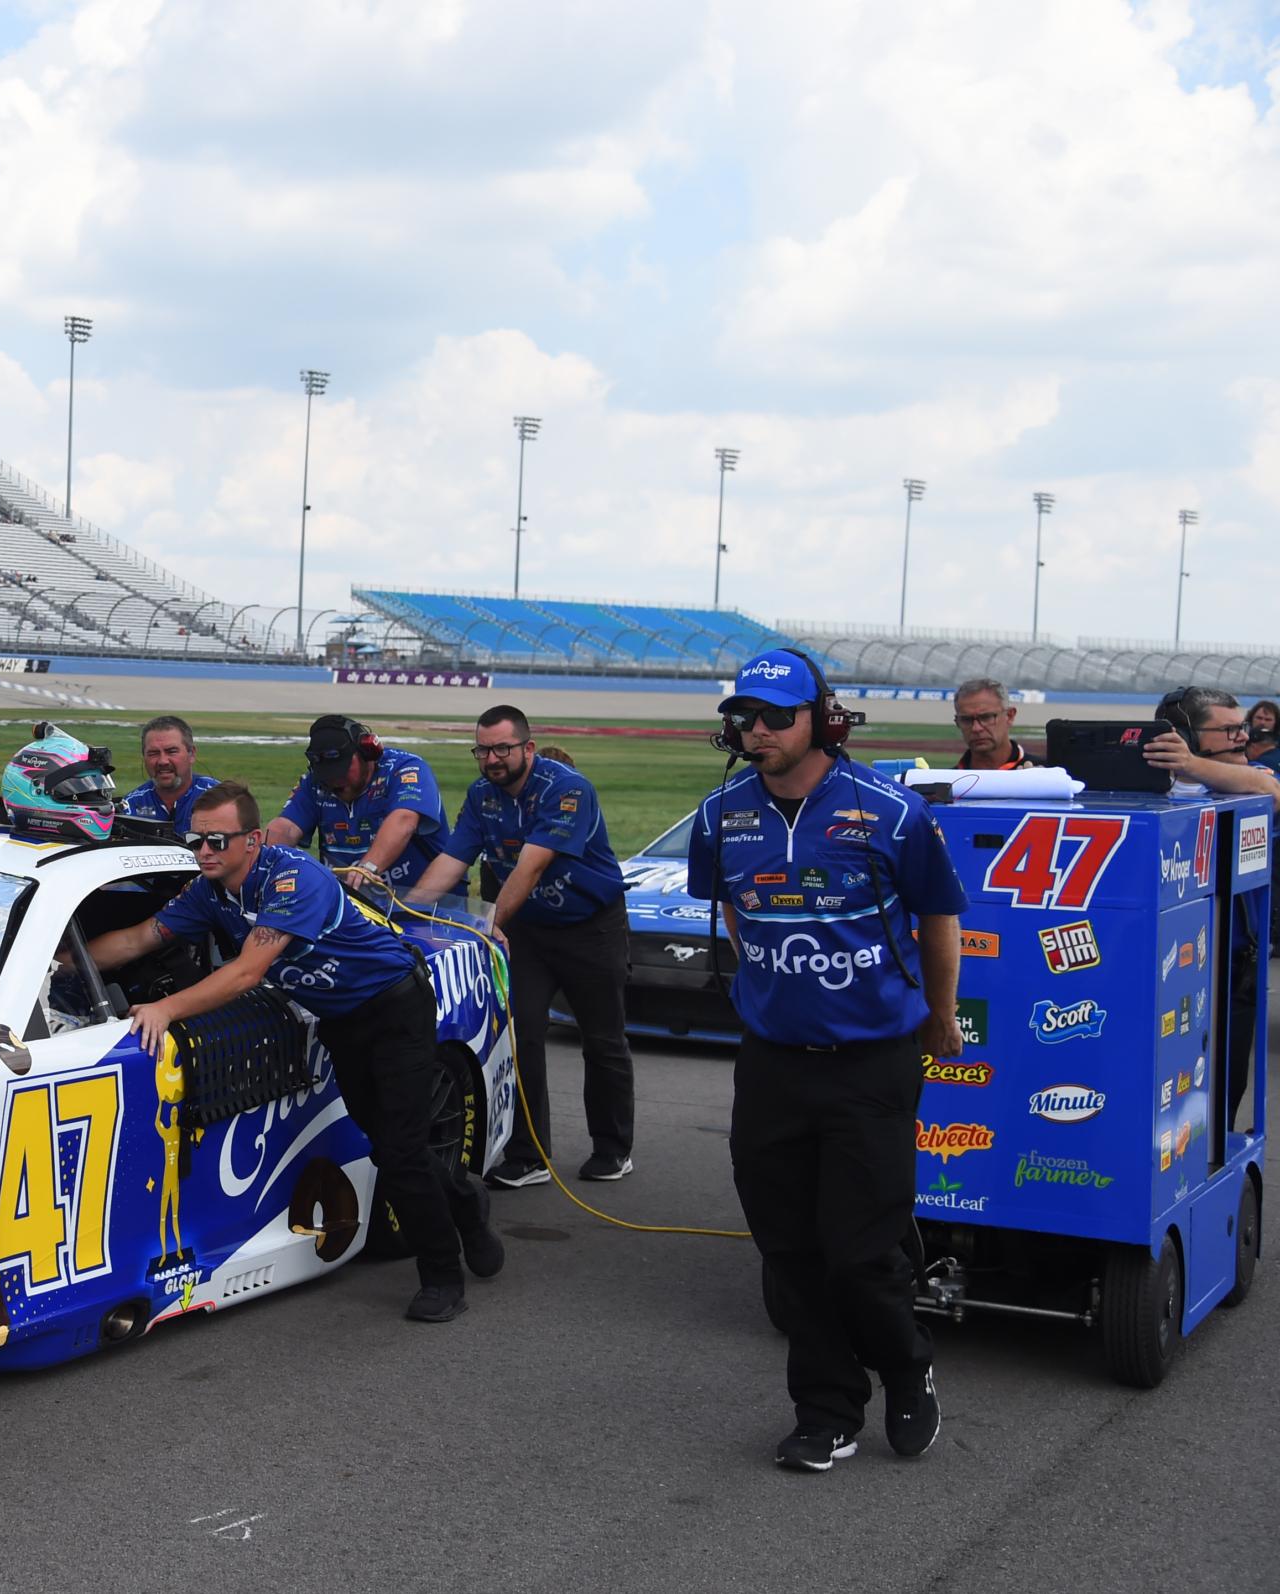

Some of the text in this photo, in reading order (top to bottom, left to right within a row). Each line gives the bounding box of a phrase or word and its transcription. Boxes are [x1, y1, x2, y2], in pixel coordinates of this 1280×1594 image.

[751, 661, 791, 679] Kroger
[1194, 807, 1216, 888] 47
[1241, 827, 1266, 848] HONDA
[982, 812, 1131, 912] 47
[1170, 841, 1191, 898] Kroger
[816, 896, 846, 906] NOS
[771, 933, 882, 990] Kroger
[1042, 1001, 1093, 1032] Scott
[1029, 1090, 1105, 1114] Minute
[461, 1094, 475, 1167] EAGLE
[1014, 1158, 1114, 1188] farmer
[1029, 1149, 1089, 1171] frozen
[915, 1192, 985, 1212] weetLeaf
[165, 1269, 202, 1295] GLORY
